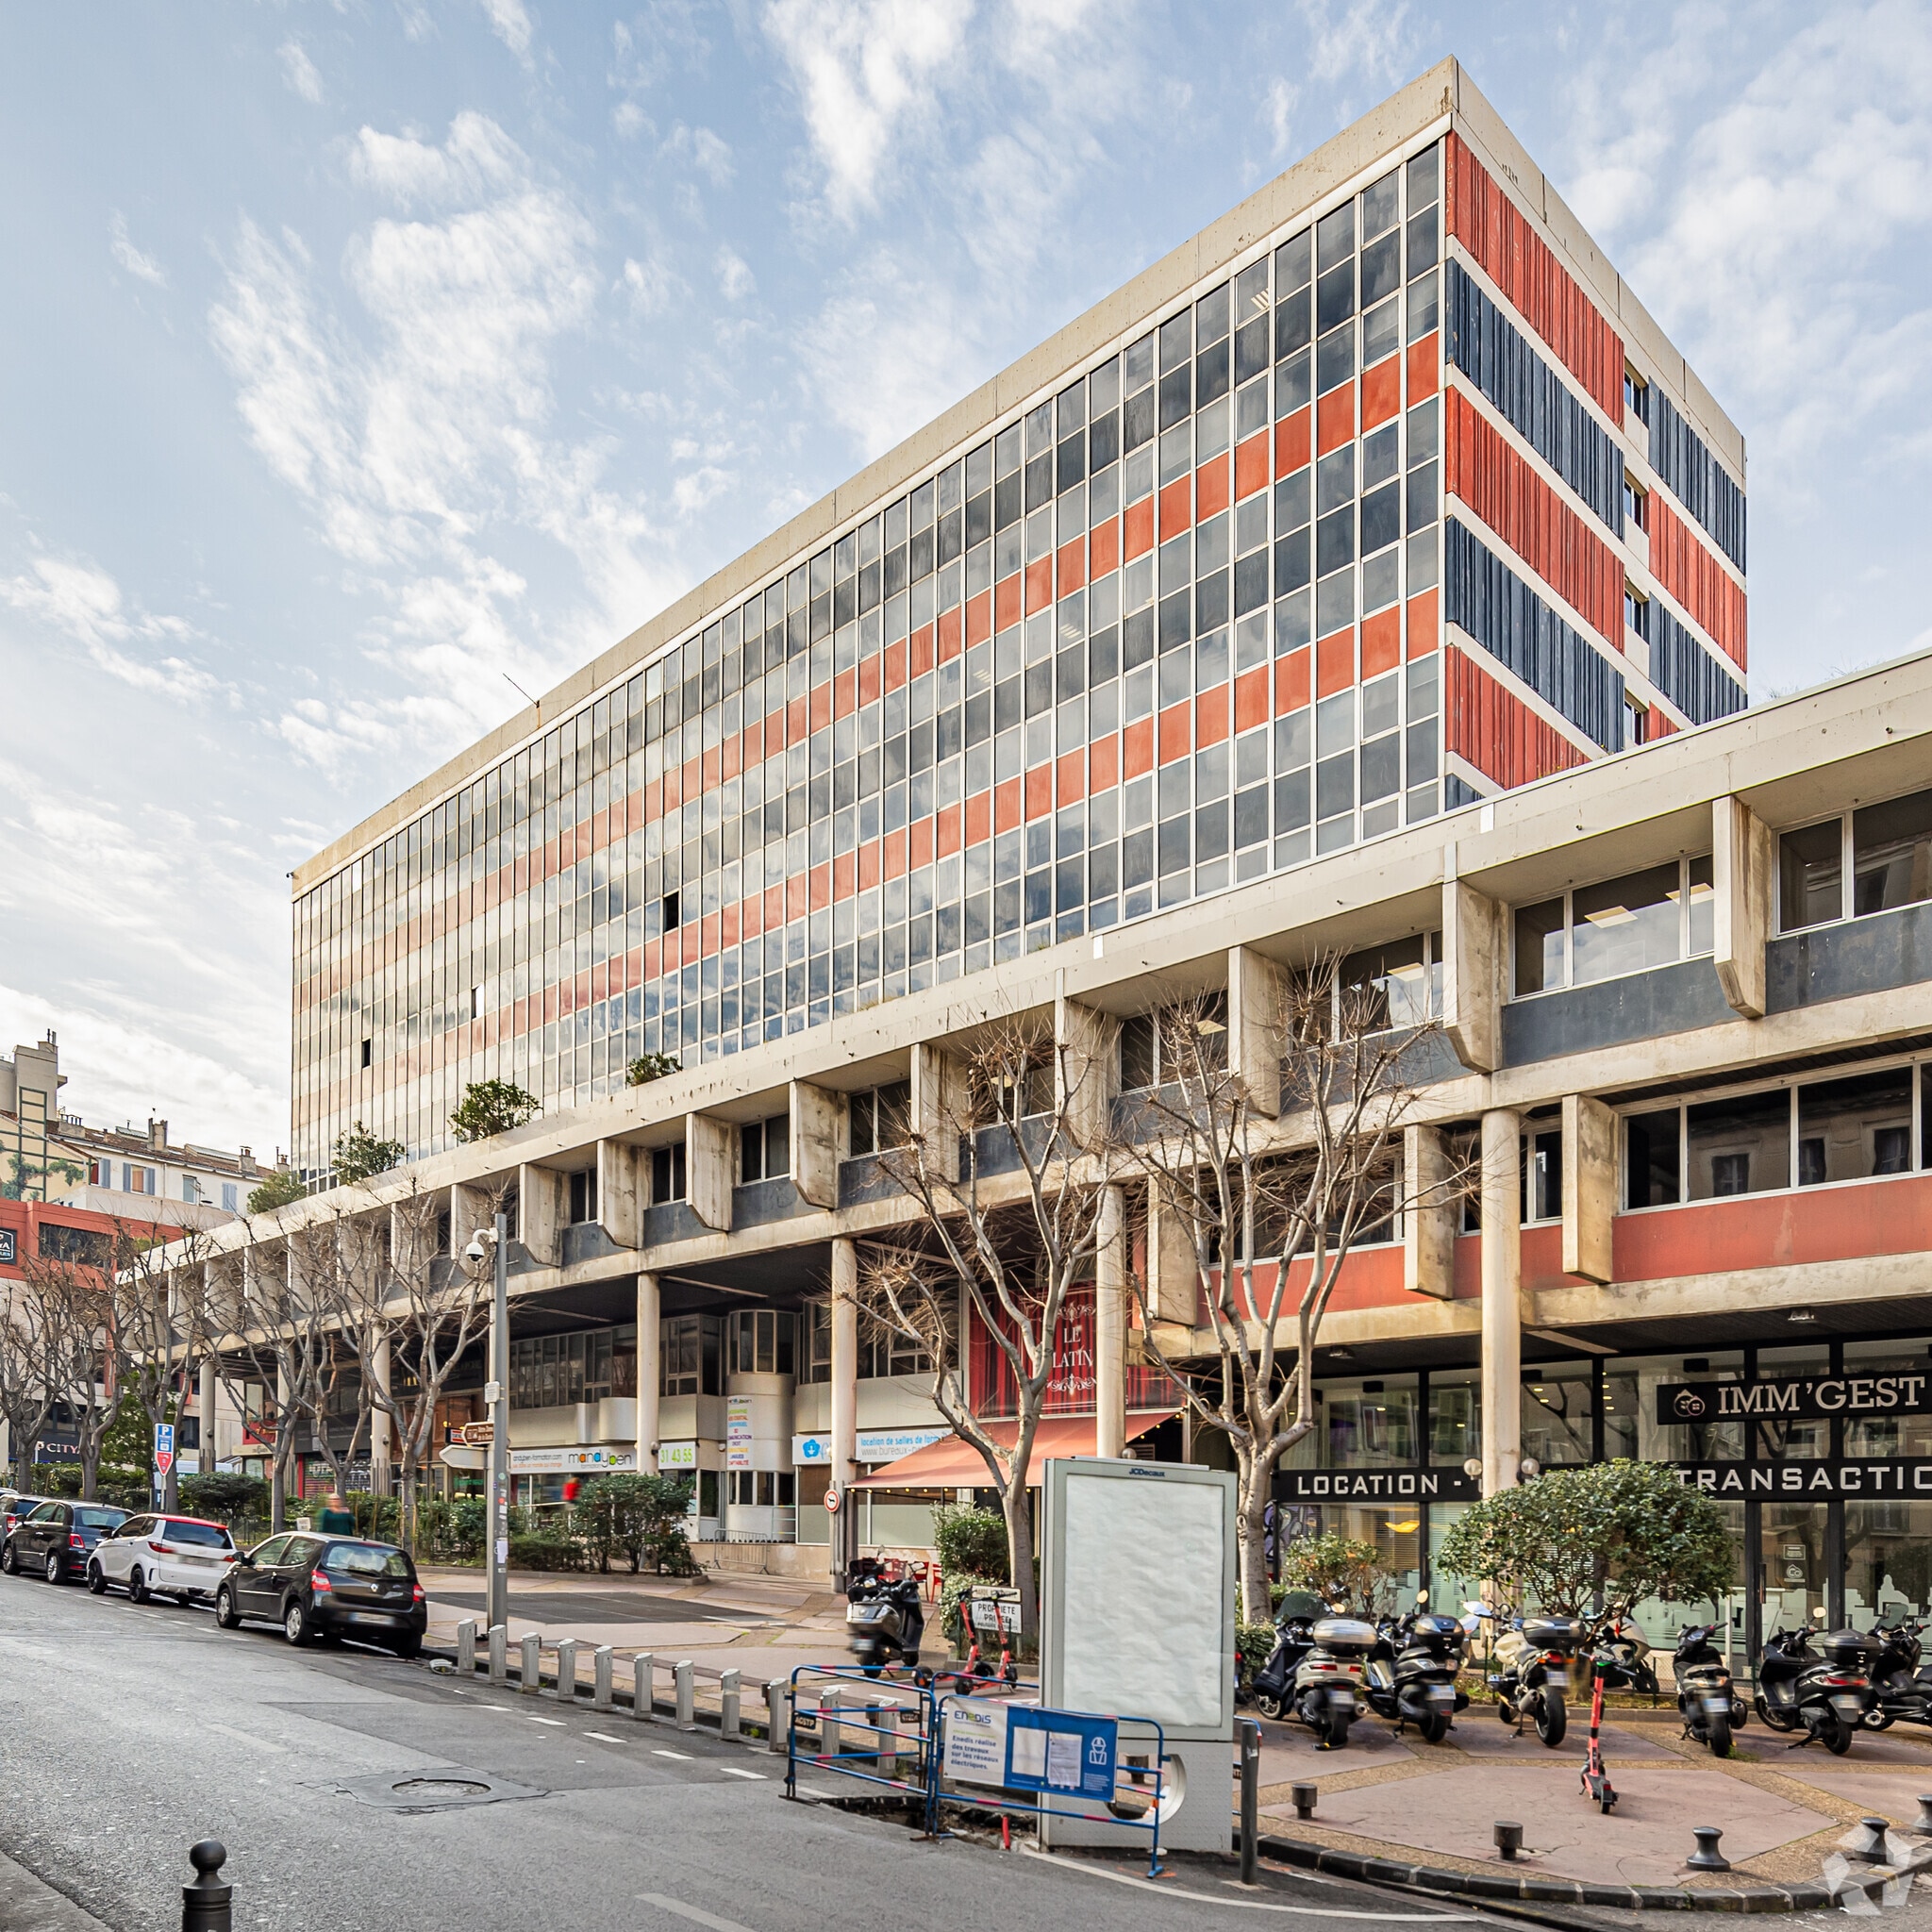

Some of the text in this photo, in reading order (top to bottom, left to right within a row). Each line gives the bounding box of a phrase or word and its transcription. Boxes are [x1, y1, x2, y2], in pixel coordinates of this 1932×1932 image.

[1063, 1326, 1081, 1343] LE
[1052, 1349, 1092, 1368] LATIN
[1717, 1375, 1926, 1414] IMM'GEST
[161, 1425, 169, 1435] P
[860, 1437, 885, 1446] location
[886, 1436, 893, 1445] de
[895, 1435, 913, 1445] salles
[915, 1435, 923, 1444] de
[660, 1448, 693, 1463] 31 43 55
[1297, 1474, 1439, 1495] LOCATION
[977, 1603, 1016, 1615] PROPIETE
[984, 1613, 1010, 1624] PRIEE
[952, 1735, 996, 1747] Enedis réalise
[964, 1745, 990, 1755] travaux
[962, 1751, 973, 1759] les
[974, 1754, 999, 1763] réseaux
